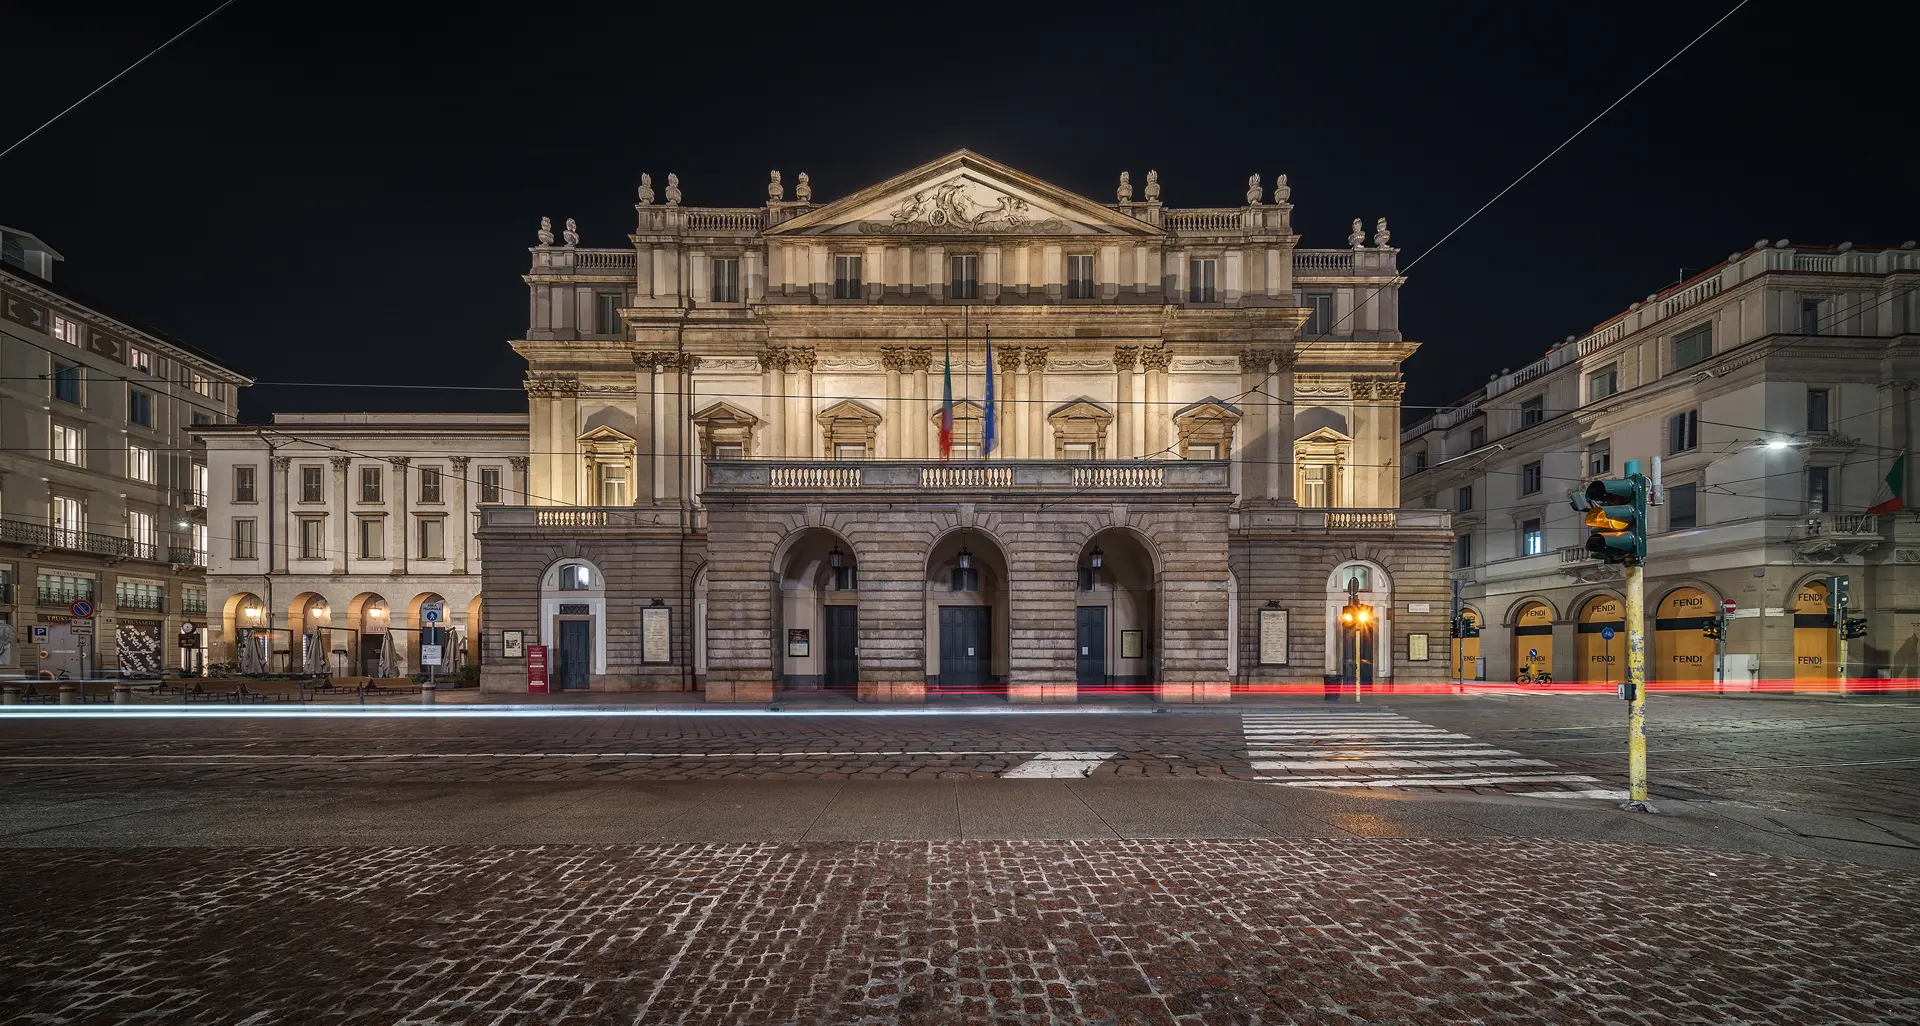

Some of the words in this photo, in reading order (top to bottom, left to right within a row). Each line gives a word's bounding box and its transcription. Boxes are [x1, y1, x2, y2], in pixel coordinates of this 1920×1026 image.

[1798, 593, 1823, 602] FENDI
[1673, 598, 1703, 607] FENDI
[1591, 604, 1616, 612] FENDI
[1526, 609, 1546, 617] FENDI
[1673, 655, 1702, 663] FENDI
[1798, 656, 1822, 664] FENDI
